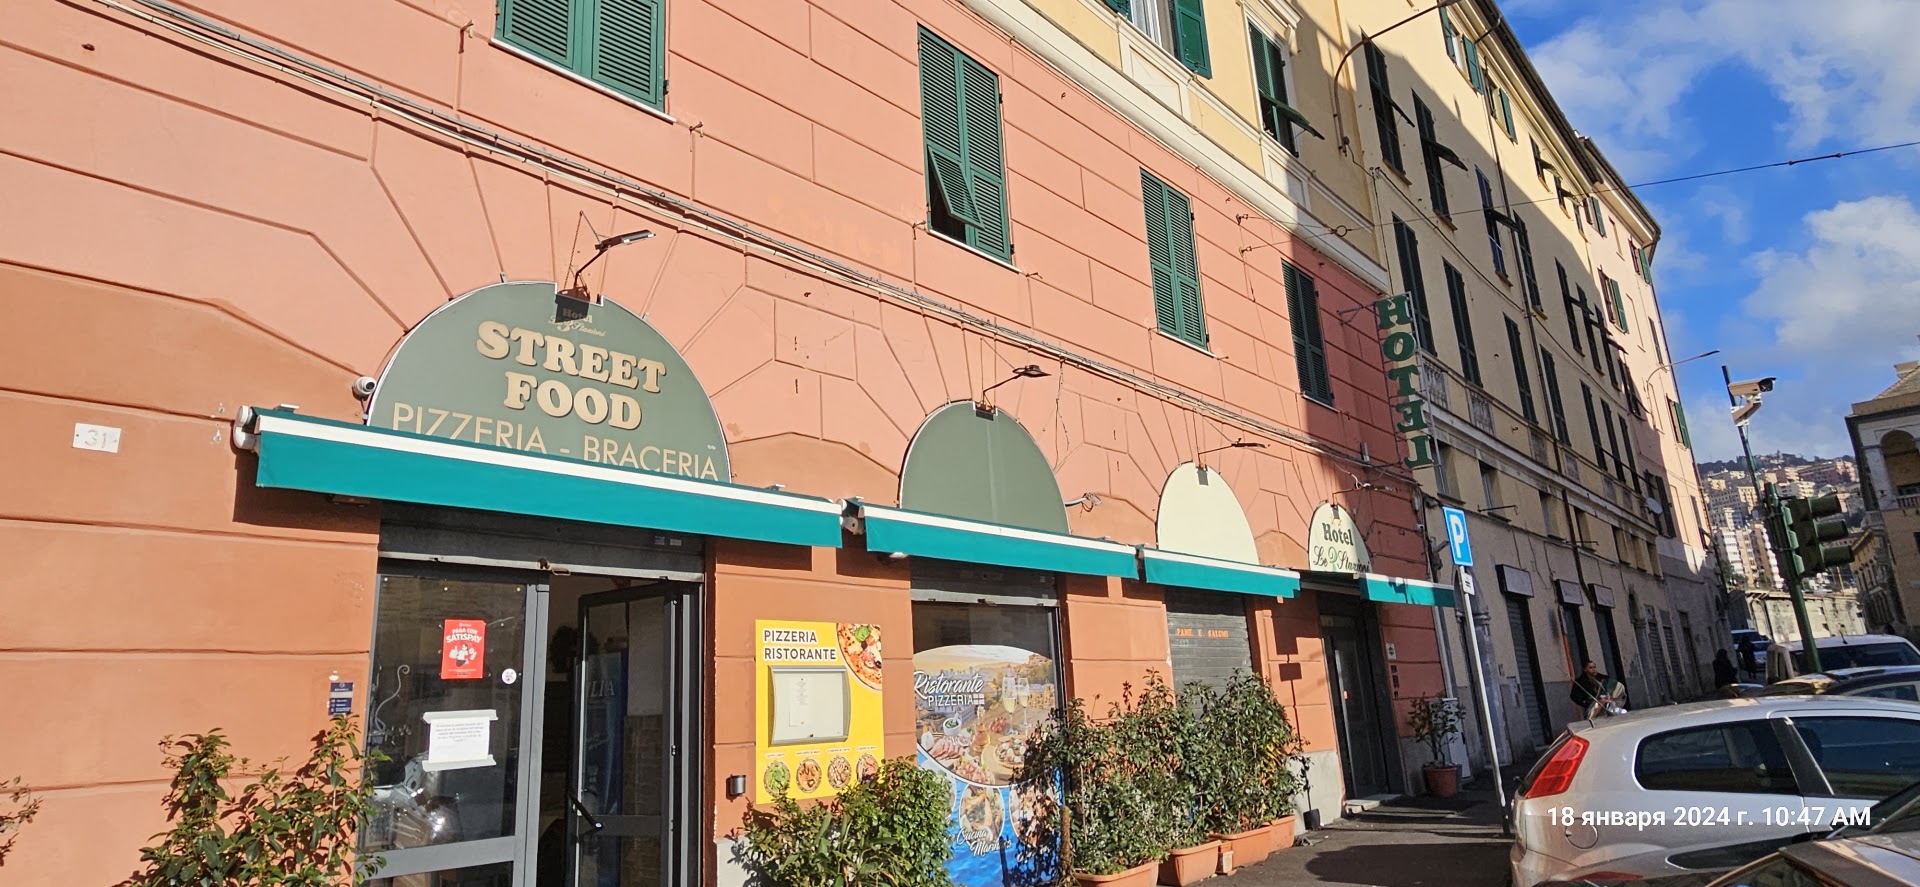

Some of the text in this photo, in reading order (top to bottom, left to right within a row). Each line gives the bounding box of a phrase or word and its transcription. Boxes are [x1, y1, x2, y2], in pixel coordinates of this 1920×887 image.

[476, 320, 666, 394] STREET
[503, 371, 643, 431] FOOD
[392, 402, 547, 455] PIZZERIA
[583, 434, 719, 482] BRACERIA
[1322, 522, 1354, 546] Hotel
[1449, 514, 1465, 558] P
[1313, 545, 1328, 567] Le
[446, 633, 482, 643] SATISPAY
[764, 630, 817, 643] PIZZERIA
[764, 647, 837, 660] RISTORANTE
[913, 670, 984, 700] Ristorante
[928, 694, 973, 707] PIZZERIA
[957, 826, 987, 845] Cucina
